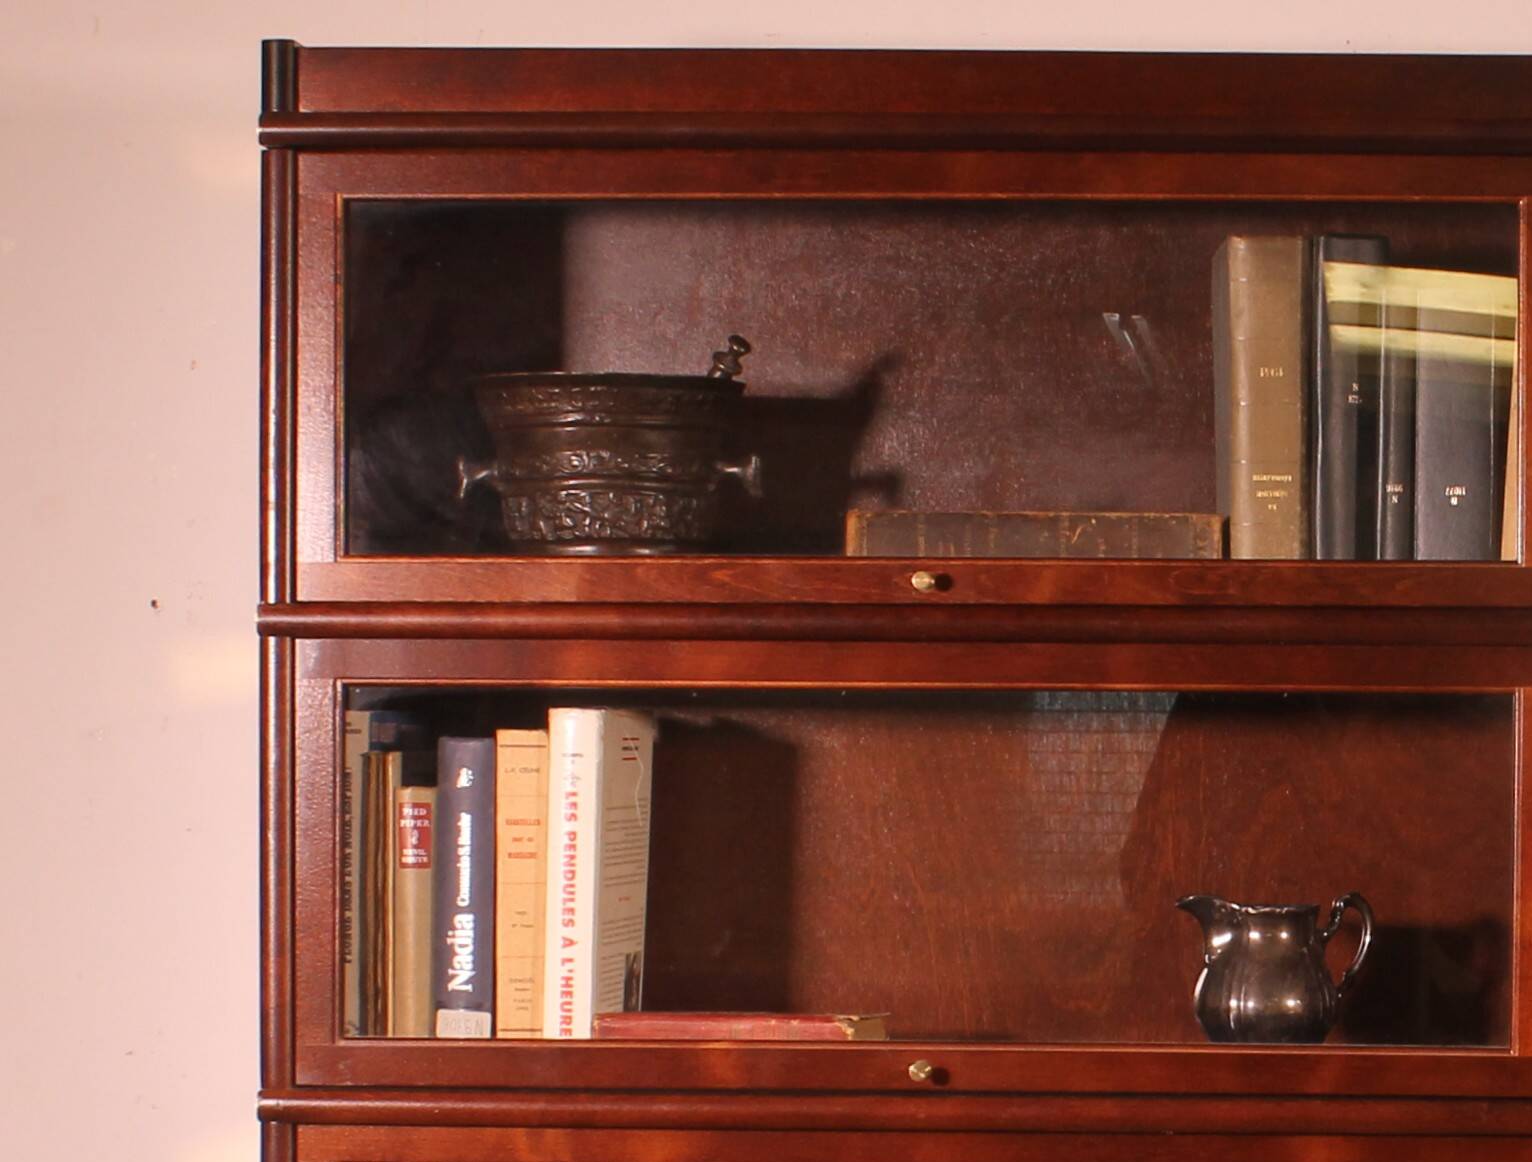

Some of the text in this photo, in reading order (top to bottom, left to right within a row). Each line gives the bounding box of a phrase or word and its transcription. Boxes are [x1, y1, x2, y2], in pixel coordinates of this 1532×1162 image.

[564, 791, 578, 822] LES
[561, 830, 578, 928] PENDULES
[446, 913, 475, 993] Nadia
[558, 957, 576, 1037] L'HEURE
